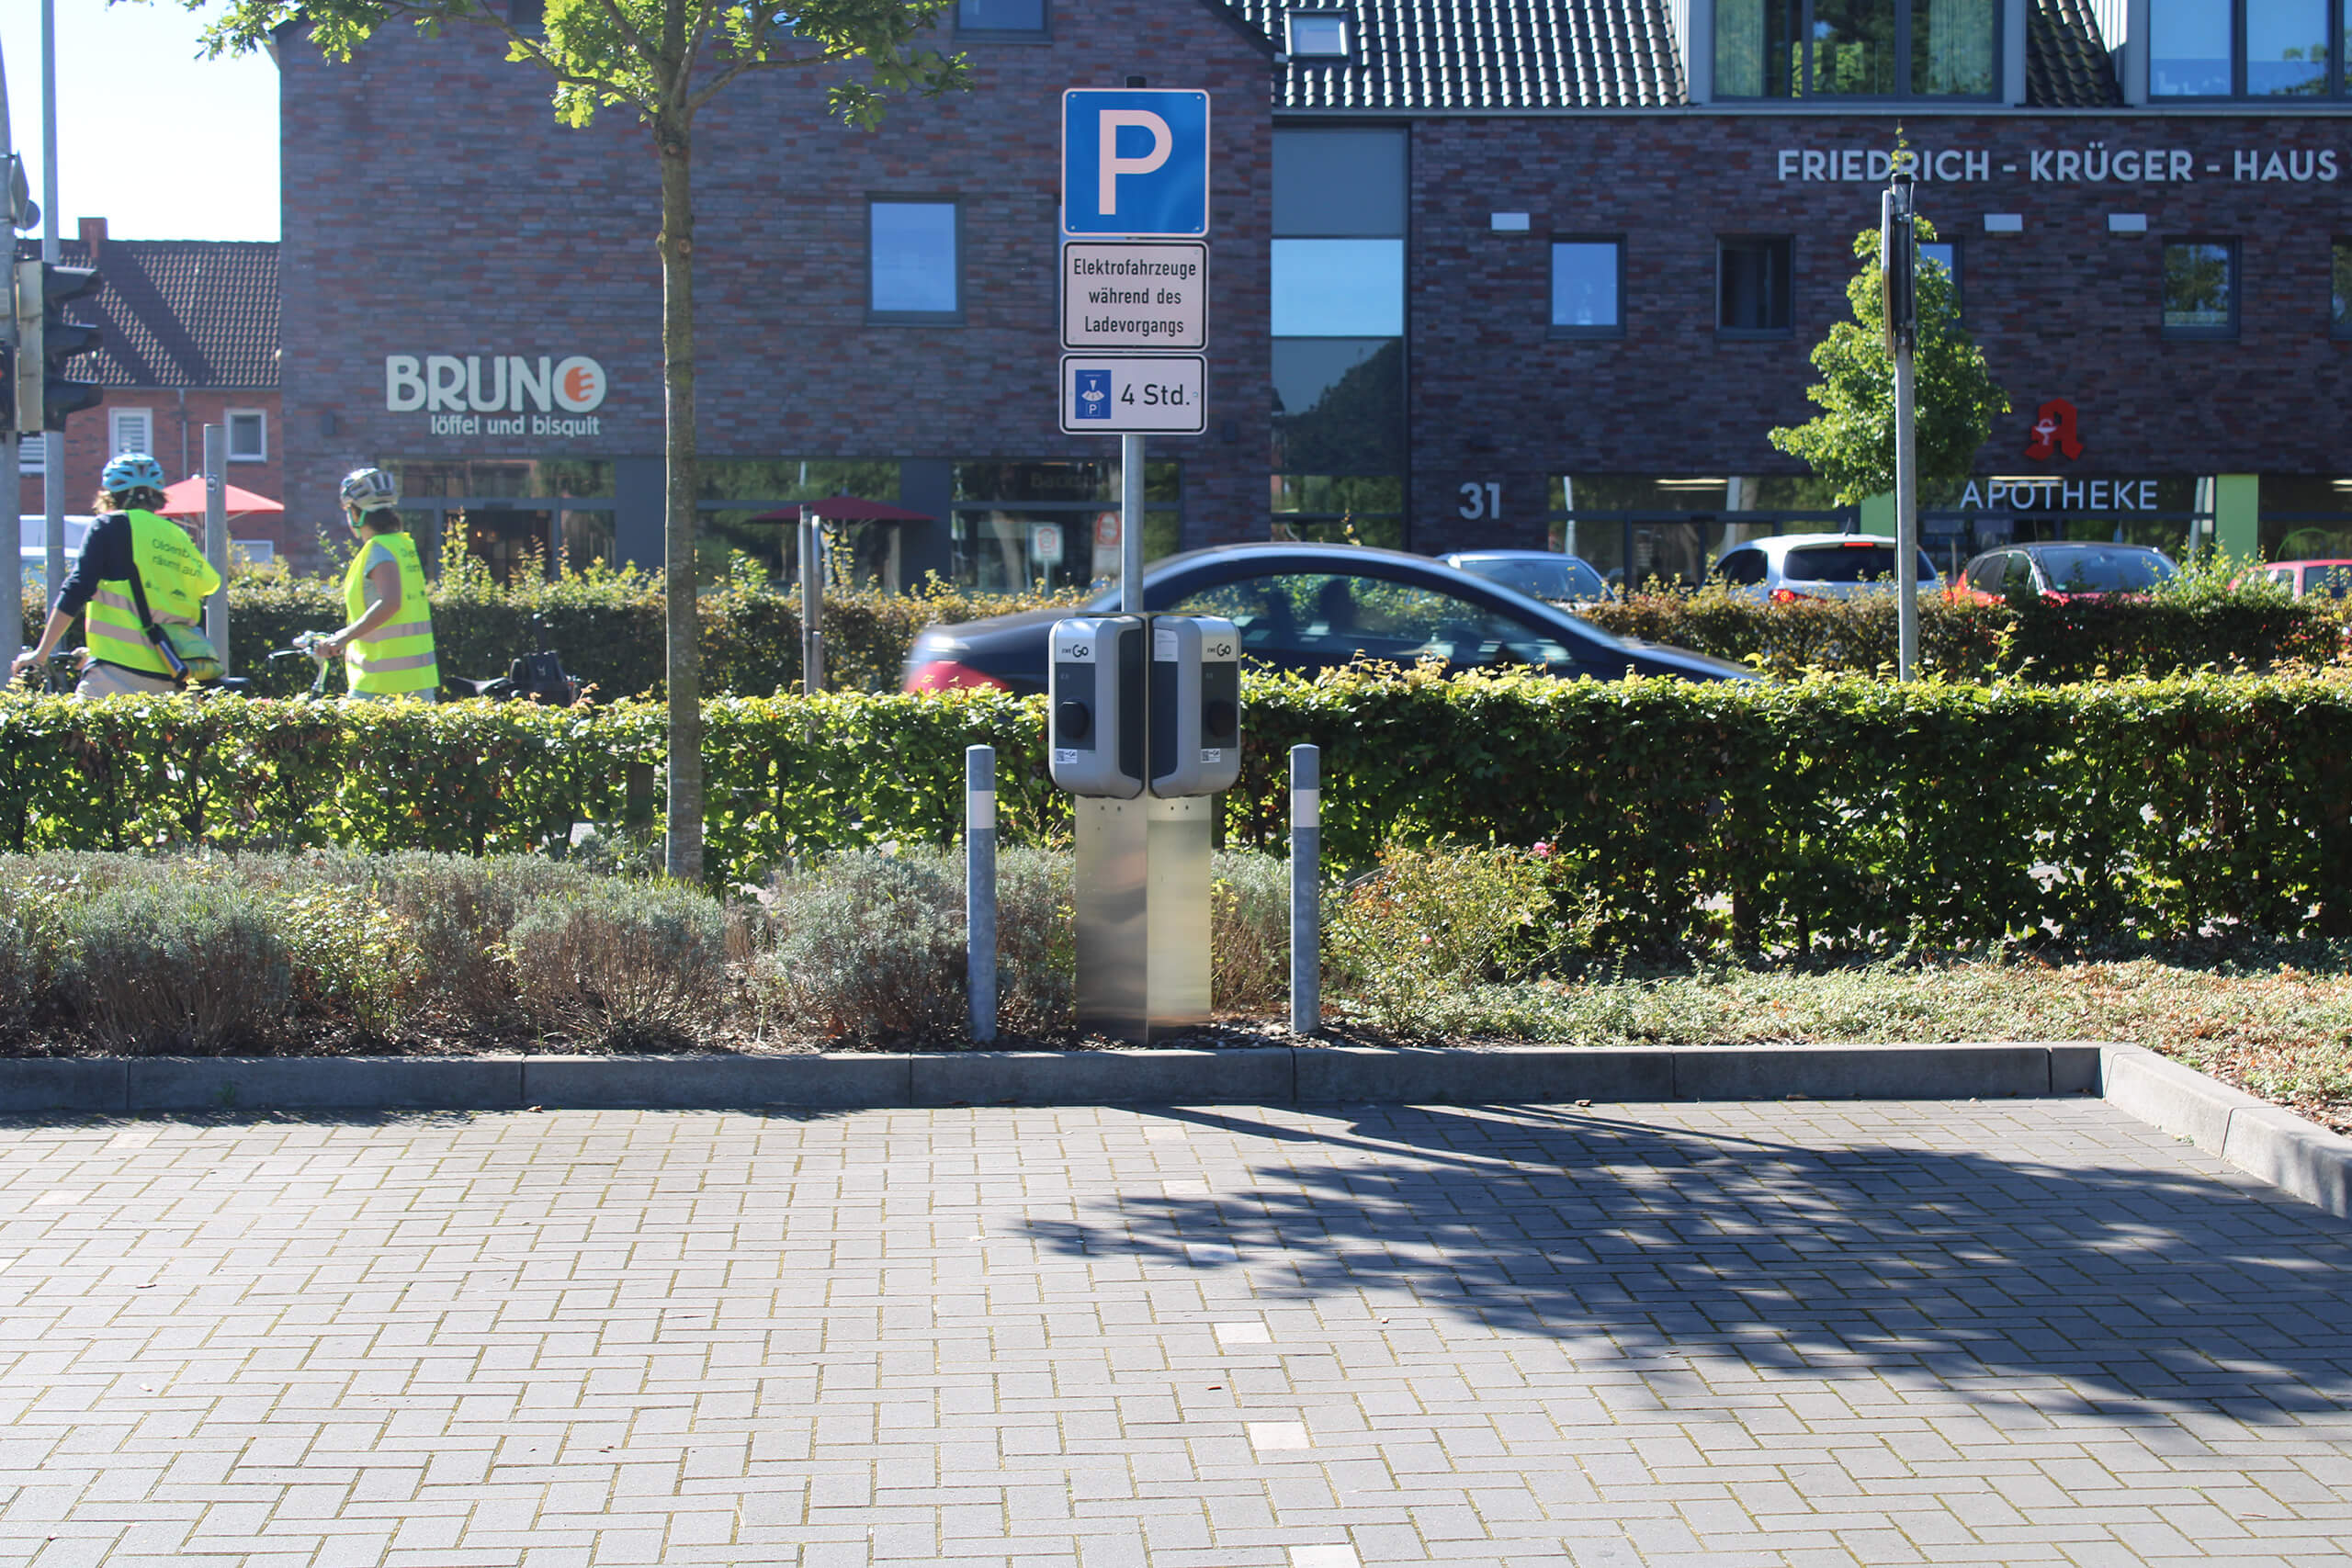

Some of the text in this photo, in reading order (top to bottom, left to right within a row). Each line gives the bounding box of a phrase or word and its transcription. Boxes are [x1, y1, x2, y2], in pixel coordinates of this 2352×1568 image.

[1099, 109, 1172, 215] P
[2030, 141, 2193, 182] KRÜGER
[2233, 150, 2338, 182] HAUS
[1073, 258, 1197, 280] Elektrofahrzeuge
[1089, 287, 1182, 304] während des
[1084, 315, 1184, 337] Ladevorgangs
[386, 355, 606, 413] BRUNO
[1120, 383, 1191, 405] 4 Std.
[431, 415, 601, 438] löffel und bisquit
[1459, 482, 1500, 520] 31
[1959, 479, 2158, 510] APOTHEKE
[1072, 644, 1089, 658] Go
[1216, 643, 1231, 657] Go
